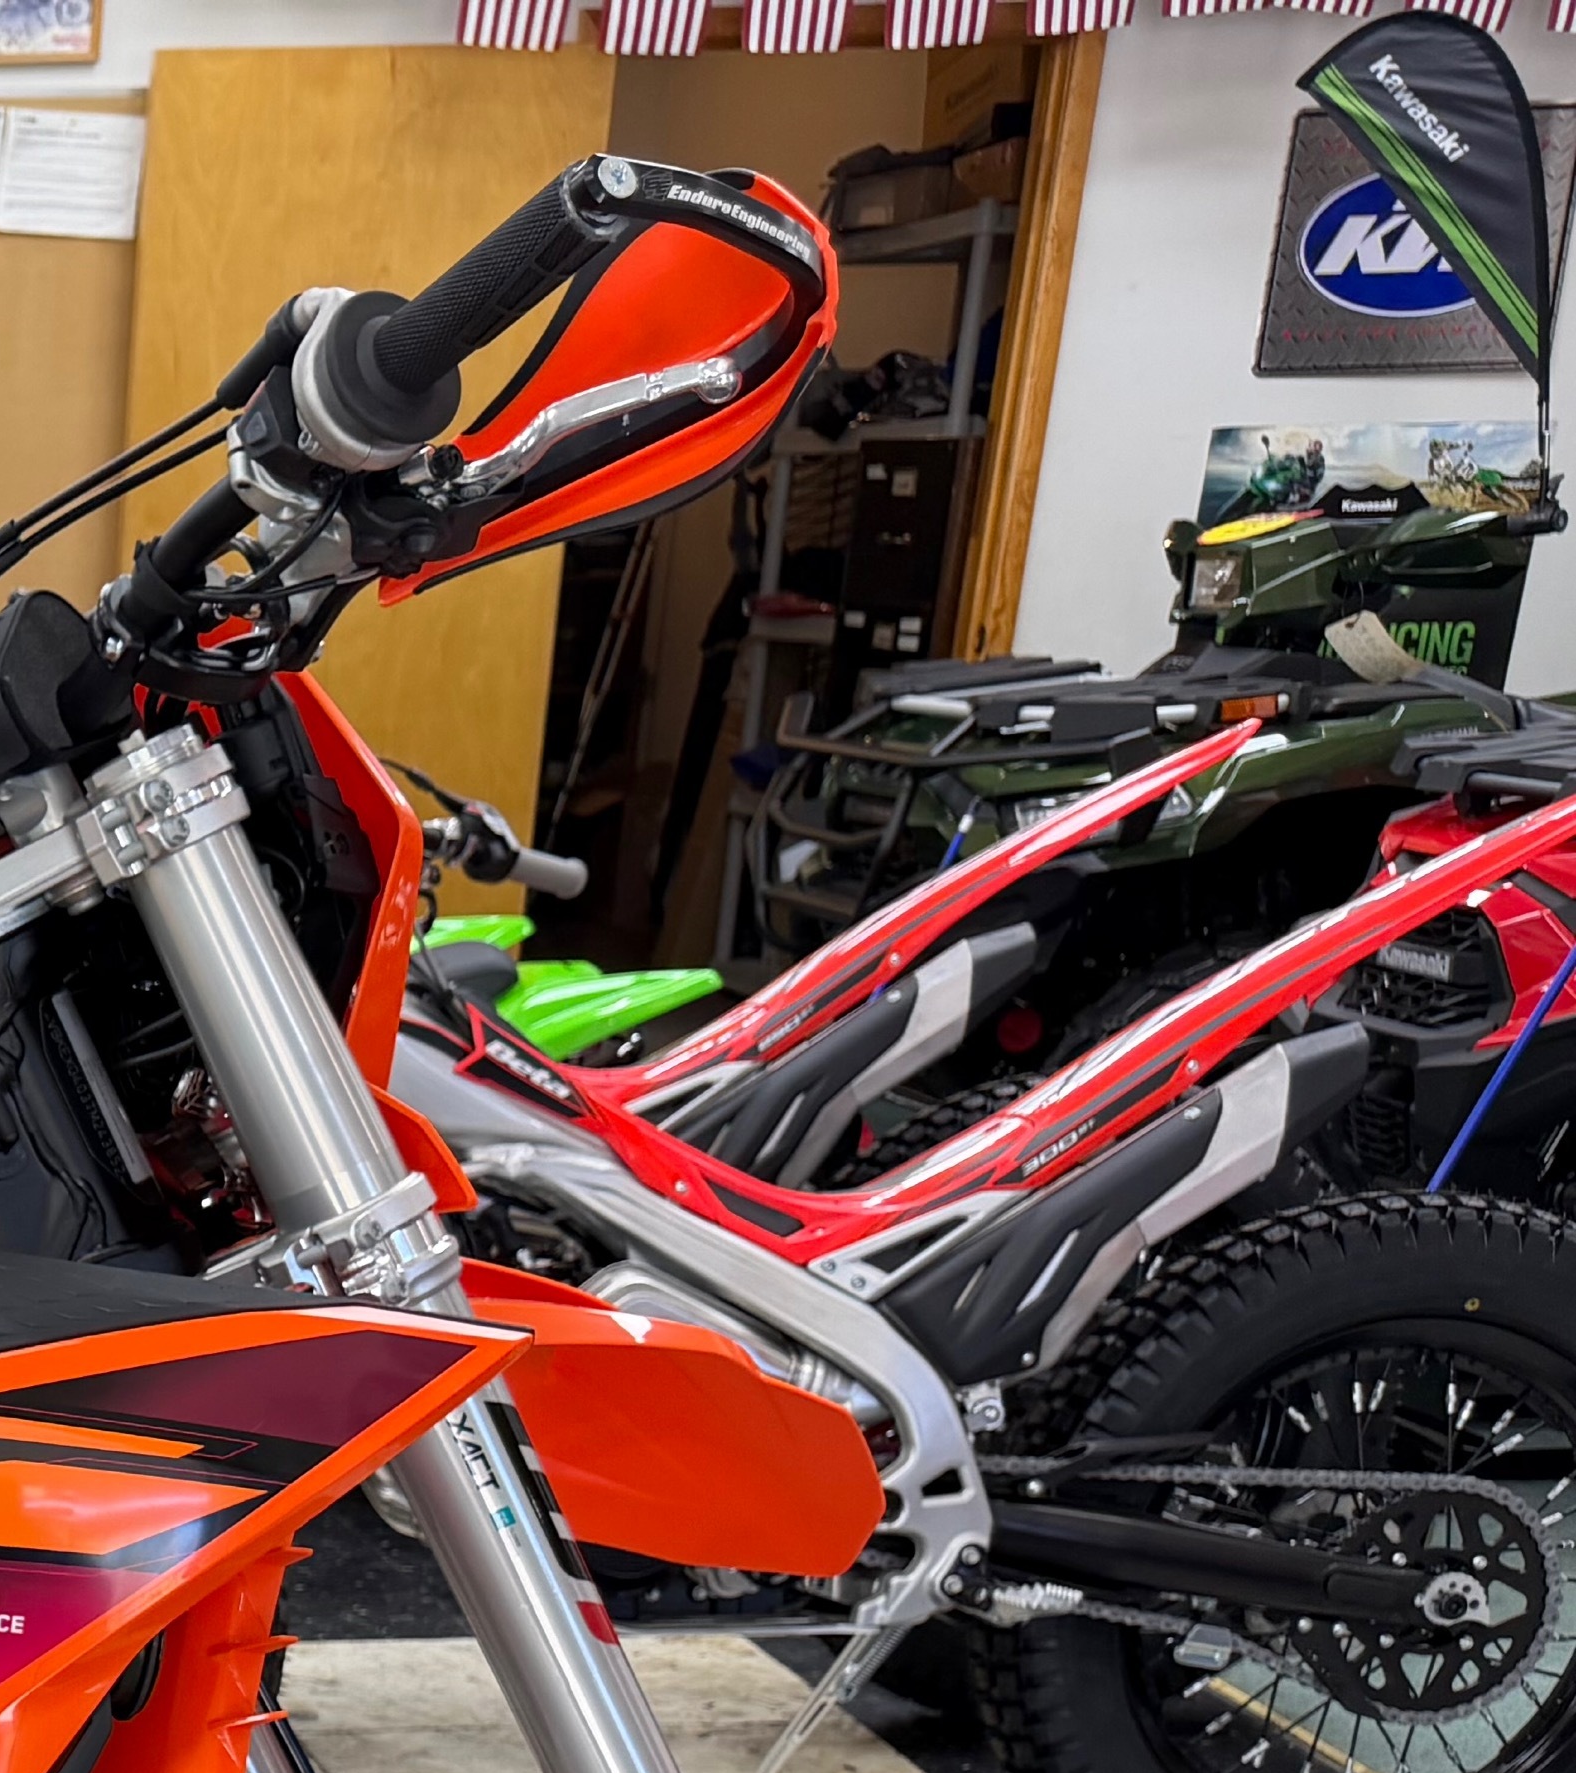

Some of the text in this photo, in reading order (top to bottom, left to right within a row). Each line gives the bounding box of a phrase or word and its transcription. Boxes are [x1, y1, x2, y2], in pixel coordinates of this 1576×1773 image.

[1367, 54, 1470, 162] Kawasaki
[1313, 198, 1454, 276] KT
[1340, 496, 1399, 516] Kawasaki
[485, 1038, 572, 1100] Beta
